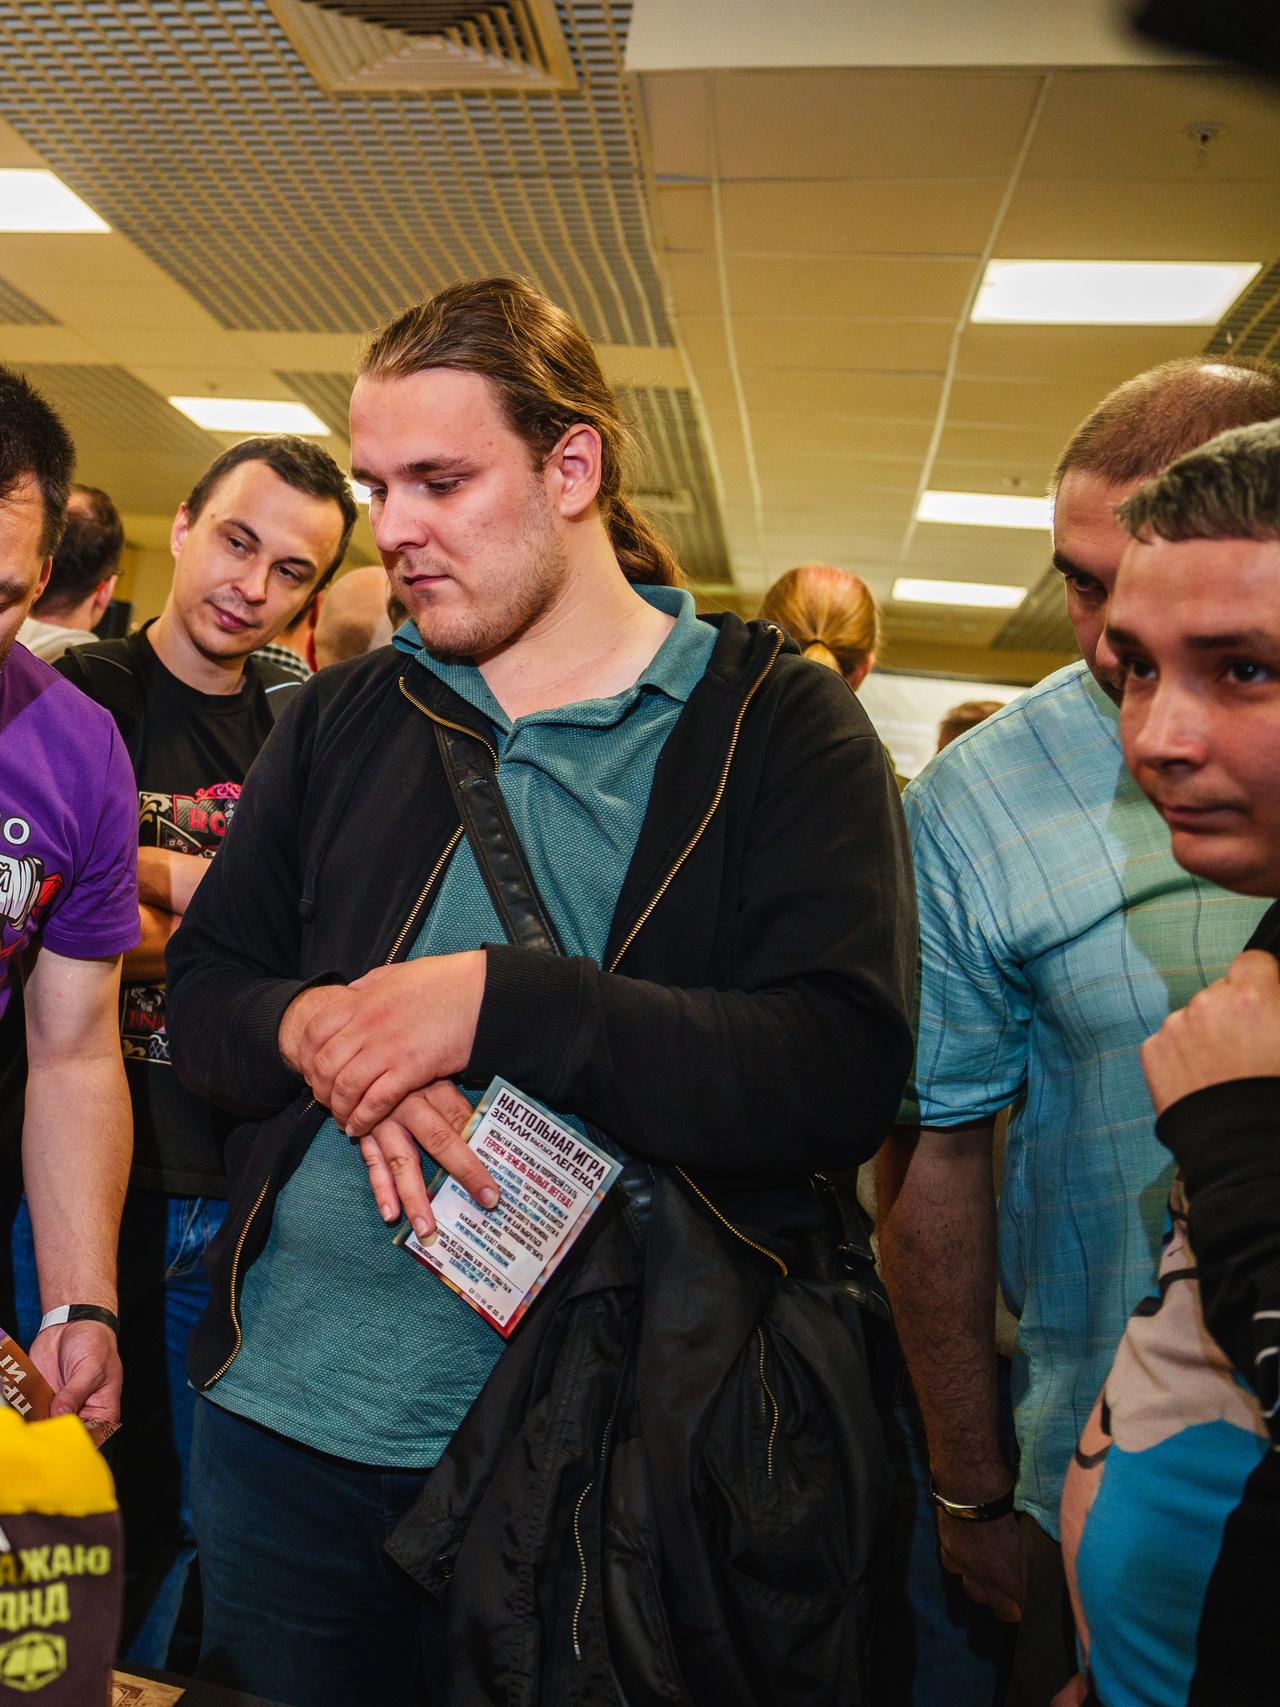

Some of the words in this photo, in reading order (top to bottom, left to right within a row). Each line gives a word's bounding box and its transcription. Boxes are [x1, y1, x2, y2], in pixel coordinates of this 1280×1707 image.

[482, 1135, 506, 1157] ГЕРОЕМ
[504, 1152, 527, 1174] ЗЕМЕЛЬ
[525, 1168, 549, 1190] БЫЛЫХ
[546, 1184, 574, 1209] ЛЕГЕНД!
[489, 1106, 531, 1141] ЗЕМЛИ
[529, 1136, 553, 1156] БЫЛЫХ
[550, 1152, 597, 1191] ЛЕГЕНД
[496, 1092, 574, 1156] НАСТОЛЬНАЯ
[571, 1147, 607, 1180] ИГРА
